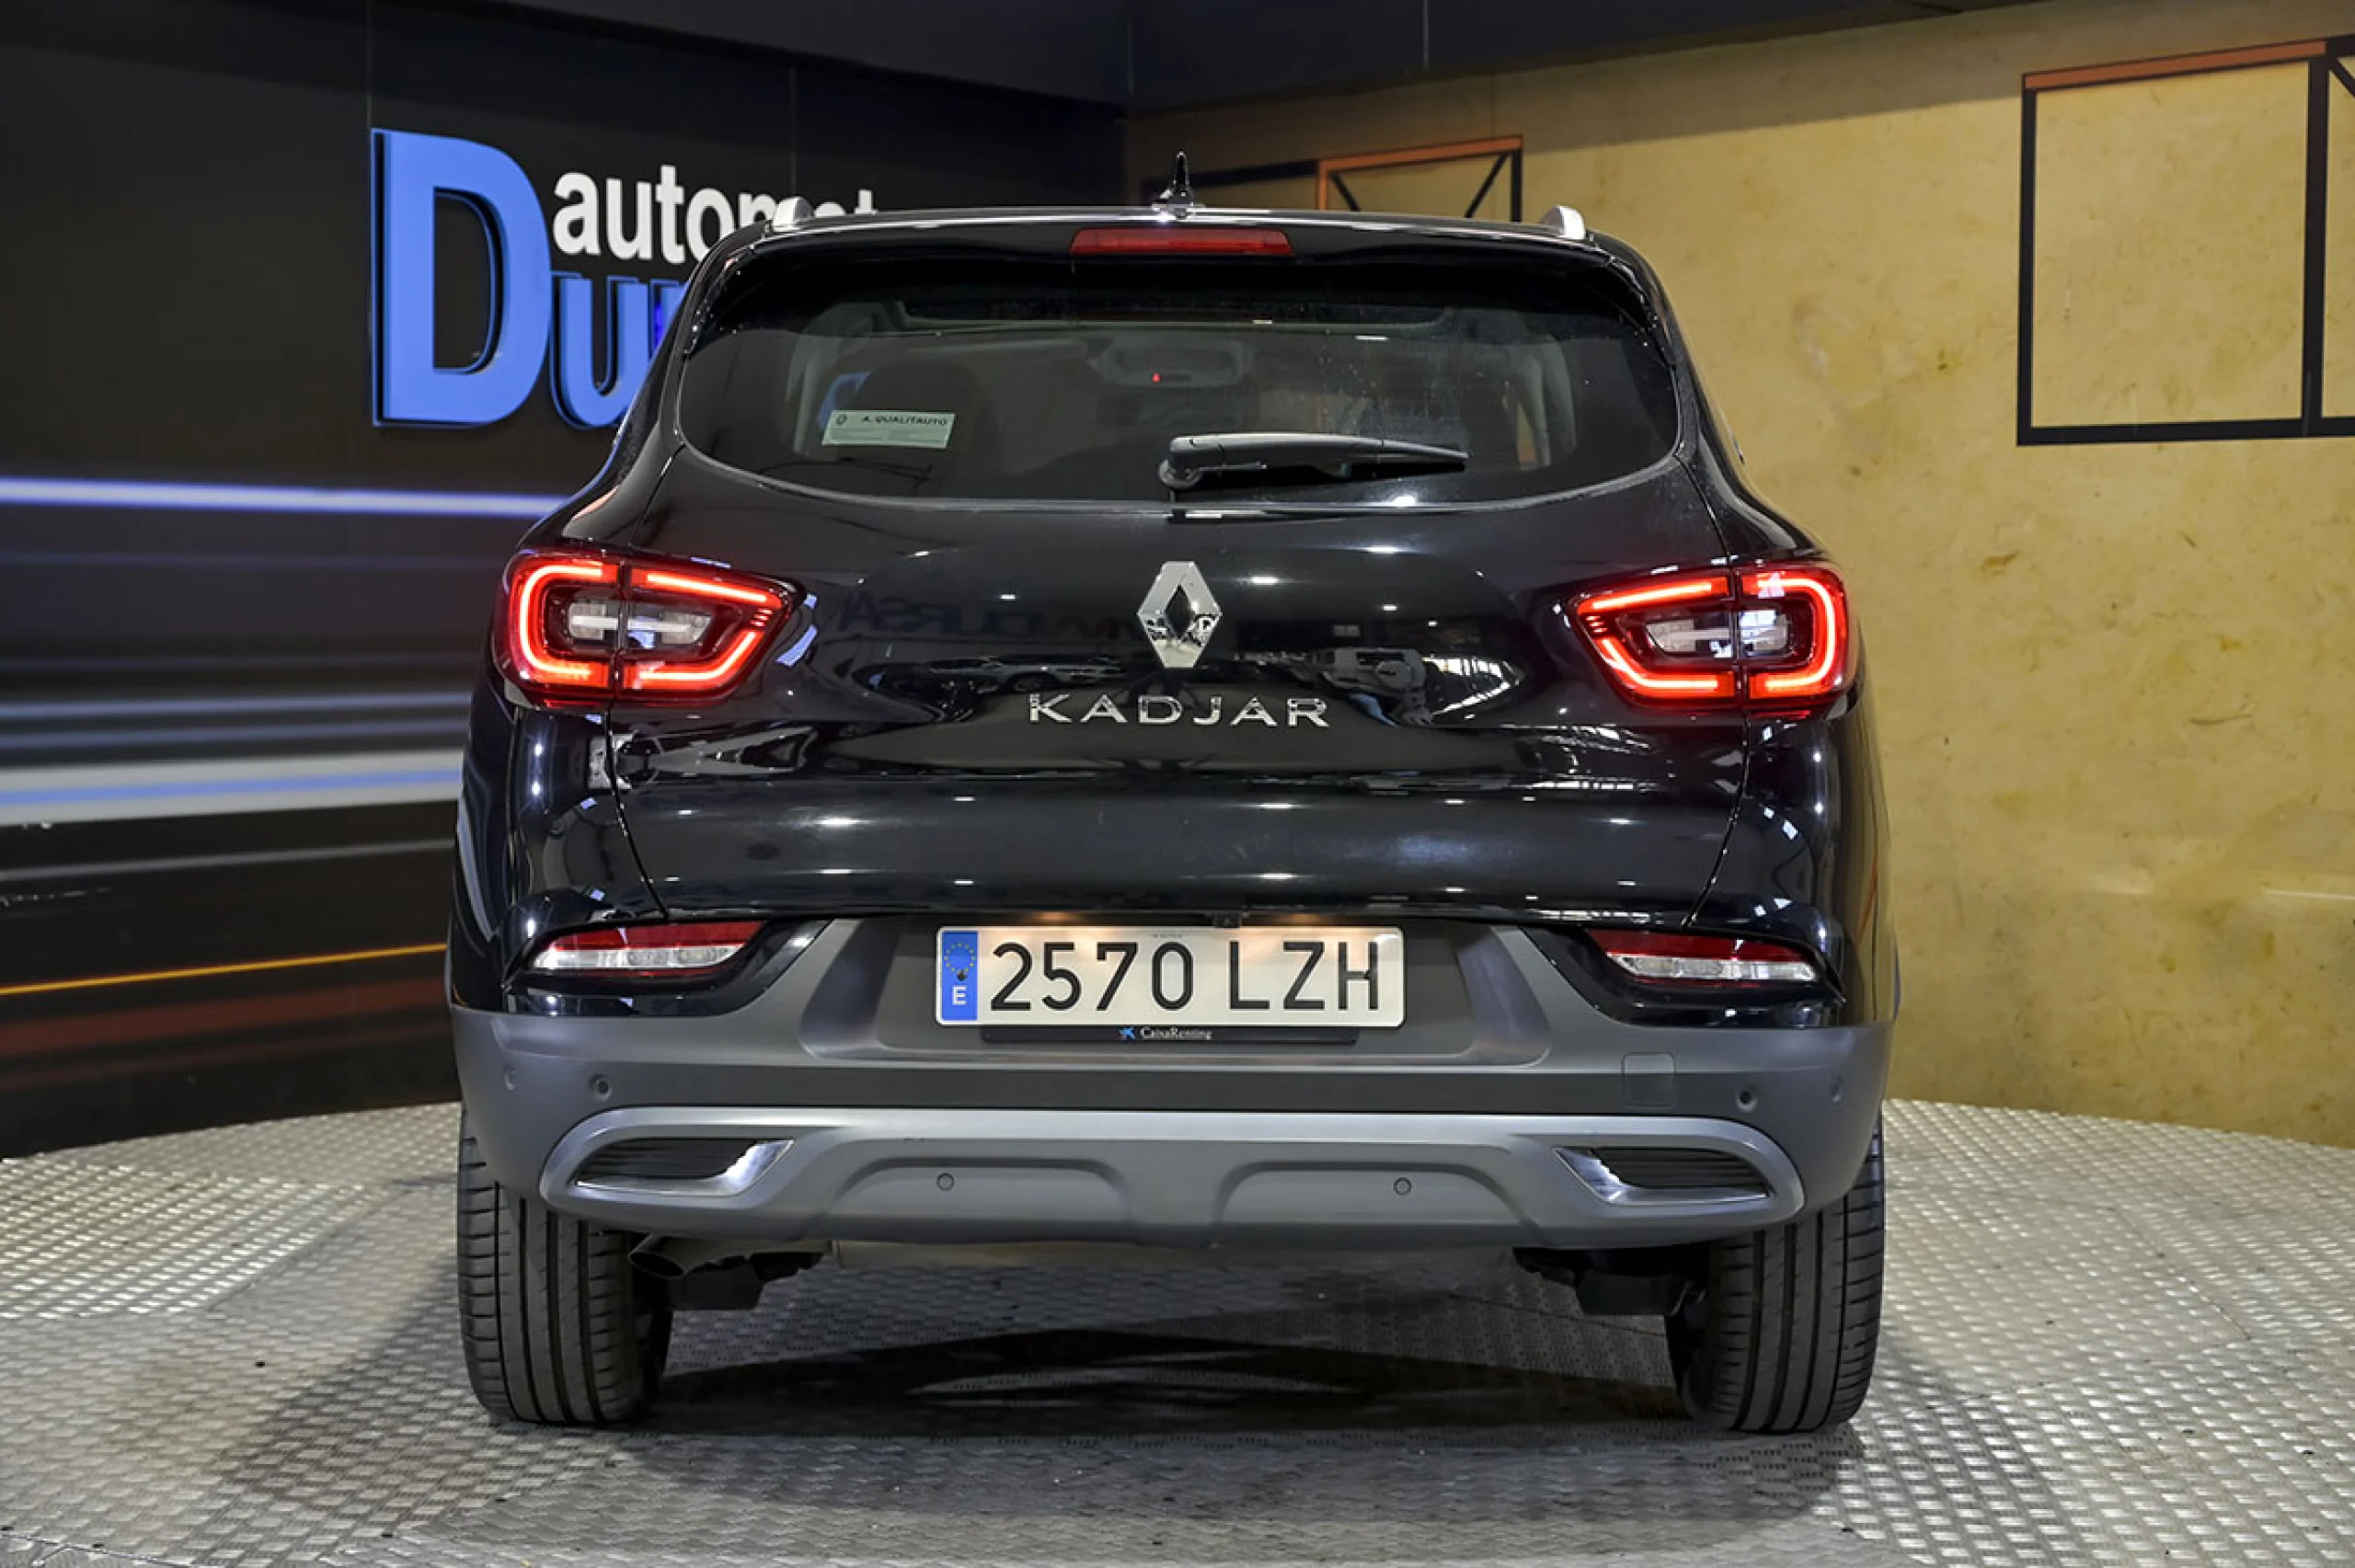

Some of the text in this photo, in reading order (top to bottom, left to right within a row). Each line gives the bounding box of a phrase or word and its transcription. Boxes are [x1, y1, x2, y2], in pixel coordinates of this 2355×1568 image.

[1028, 692, 1330, 727] KADJAR
[990, 940, 1380, 1012] 2570 LZH
[950, 986, 968, 1007] E
